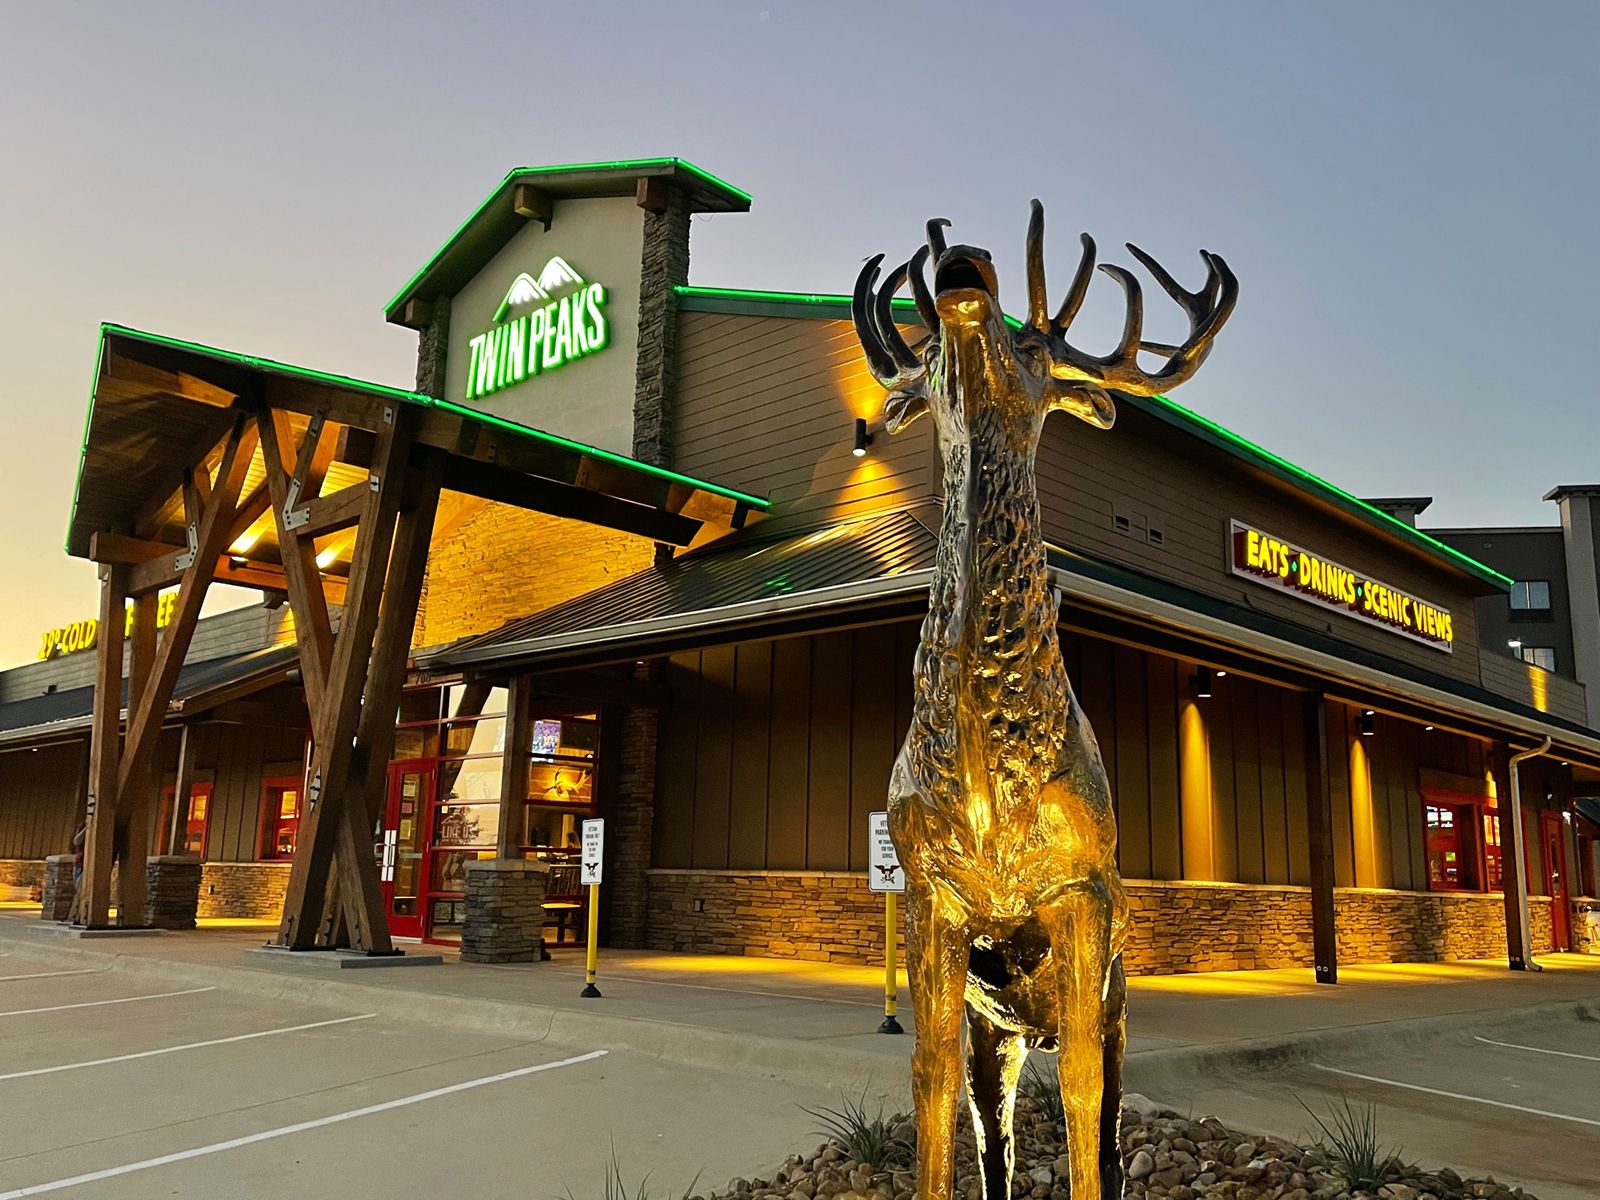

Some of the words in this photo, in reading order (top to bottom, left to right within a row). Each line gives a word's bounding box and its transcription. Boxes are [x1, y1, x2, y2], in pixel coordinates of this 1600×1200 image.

[466, 316, 530, 399] TWIN
[528, 282, 610, 374] PEAKS
[61, 617, 97, 654] COLD
[1247, 530, 1289, 578] EATS
[1299, 552, 1356, 604] DRINKS
[1364, 580, 1411, 627] SCENIC
[1413, 601, 1453, 642] VIEWS
